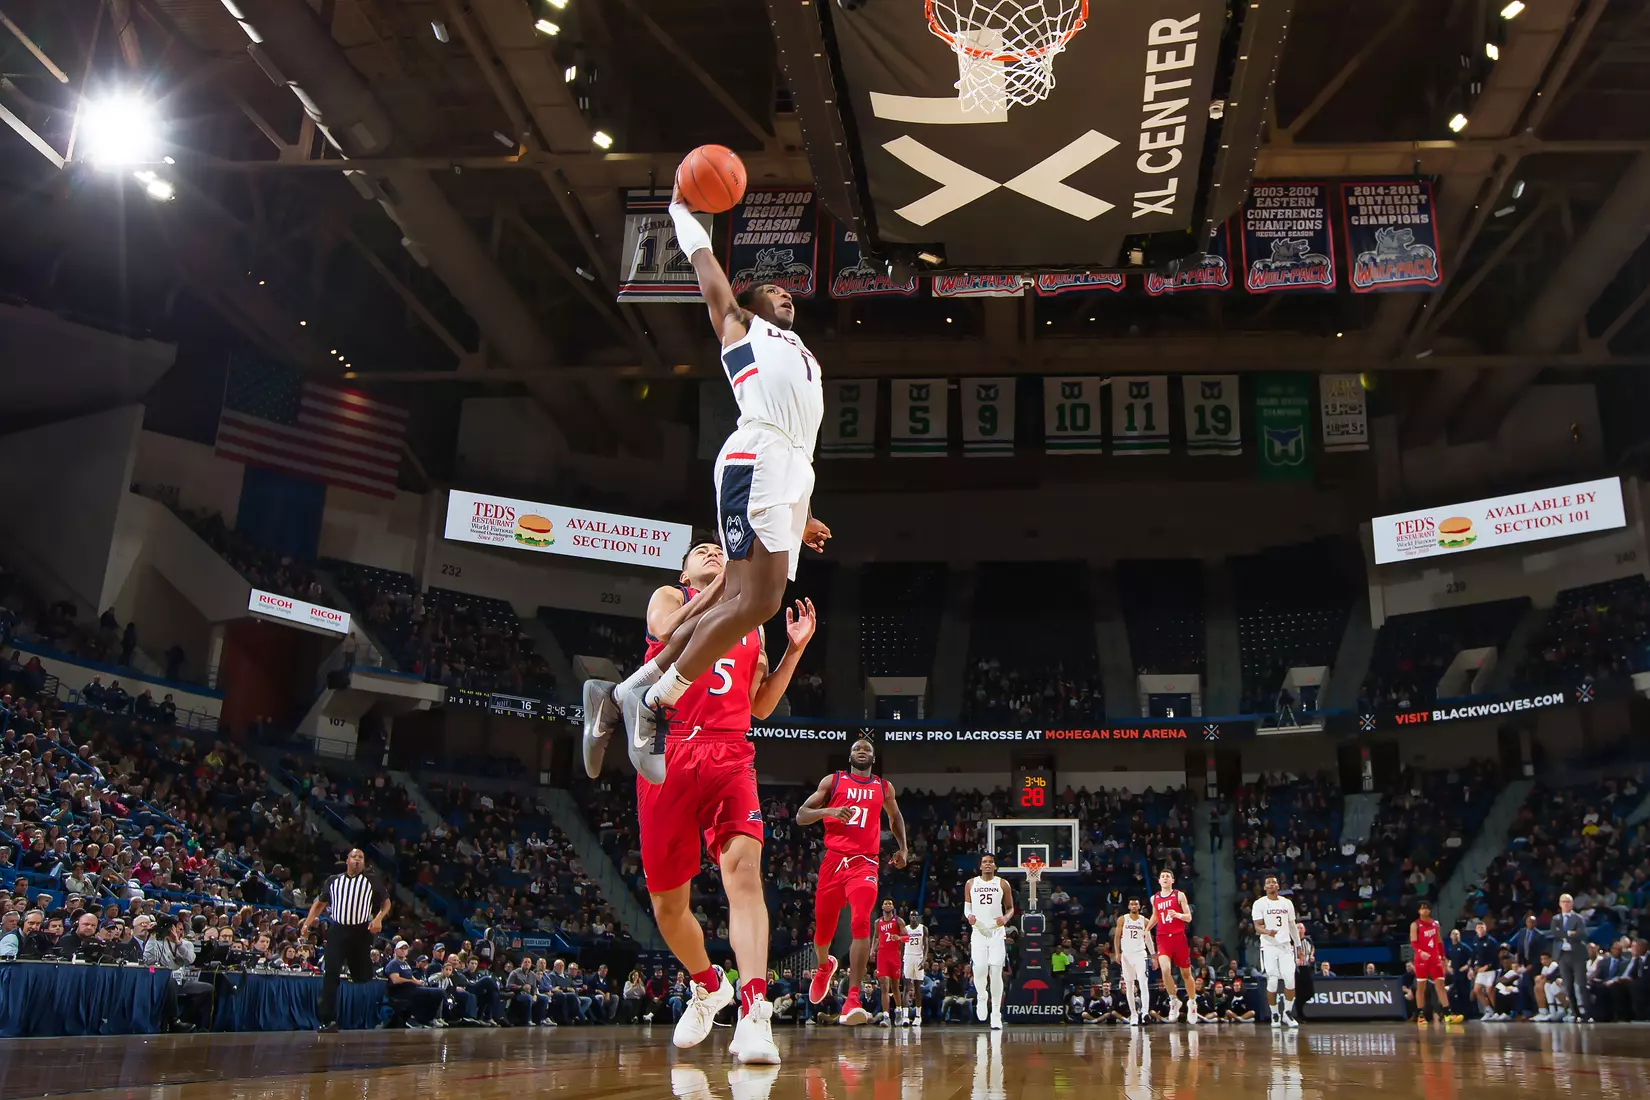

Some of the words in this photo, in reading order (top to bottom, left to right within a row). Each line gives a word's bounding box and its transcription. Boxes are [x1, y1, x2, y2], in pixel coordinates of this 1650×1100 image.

[1136, 12, 1201, 174] CENTER
[1131, 177, 1179, 218] XL
[1253, 186, 1319, 197] 2003-2004
[1256, 197, 1315, 207] EASTERN
[1348, 195, 1427, 205] NORTHEAST
[743, 206, 803, 218] REGULAR
[1247, 208, 1323, 219] CONFERENCE
[1359, 205, 1418, 215] DIVISION
[637, 219, 675, 233] GERNA
[747, 219, 800, 231] SEASON
[1247, 220, 1322, 230] CHAMPIONS
[1351, 214, 1429, 225] CHAMPIONS
[734, 231, 811, 245] CHAMPIONS
[637, 236, 694, 273] 12
[909, 405, 929, 435] 5
[978, 404, 998, 436] 9
[1055, 402, 1090, 432] 10
[1125, 402, 1155, 431] 11
[1194, 404, 1232, 436] 19
[473, 502, 515, 521] TED'S
[1485, 496, 1572, 520] AVAILABLE
[1576, 491, 1597, 505] BY
[472, 516, 514, 528] RESTAURANT
[1395, 517, 1435, 535] TED'S
[1495, 514, 1563, 535] SECTION
[1569, 510, 1590, 523] 101
[566, 517, 649, 541] AVAILABLE
[652, 530, 671, 542] BY
[1396, 531, 1435, 542] RESTAURANT
[572, 534, 638, 554] SECTION
[641, 544, 661, 557] 101
[441, 564, 462, 578] 232
[1446, 581, 1466, 594] 239
[259, 594, 293, 609] RICOH
[601, 592, 621, 605] 233
[310, 607, 342, 622] RICOH
[708, 658, 736, 695] 5
[521, 700, 532, 710] 16
[547, 704, 566, 716] 3:46
[1395, 711, 1429, 725] VISIT
[1432, 693, 1564, 722] BLACKWOLVES.COM
[329, 718, 346, 727] 107
[746, 727, 846, 741] CKWOLVES.COM
[885, 731, 923, 741] MEN'S
[927, 731, 953, 741] PRO
[957, 730, 1022, 741] LACROSSE
[1026, 730, 1042, 740] AT
[1045, 730, 1110, 740] MOHEGAN
[1113, 729, 1139, 739] SUN
[1143, 729, 1187, 739] ARENA
[1025, 776, 1047, 787] 3:46
[847, 787, 875, 802] NJIT
[1021, 787, 1044, 807] 28
[848, 805, 869, 830] 21
[979, 894, 993, 905] 25
[1157, 900, 1172, 911] NJIT
[1161, 911, 1173, 924] 14
[1276, 916, 1282, 927] 3
[880, 923, 893, 932] NJIT
[1130, 931, 1138, 939] 12
[1428, 937, 1434, 948] 4
[1006, 1005, 1064, 1015] TRAVELERS
